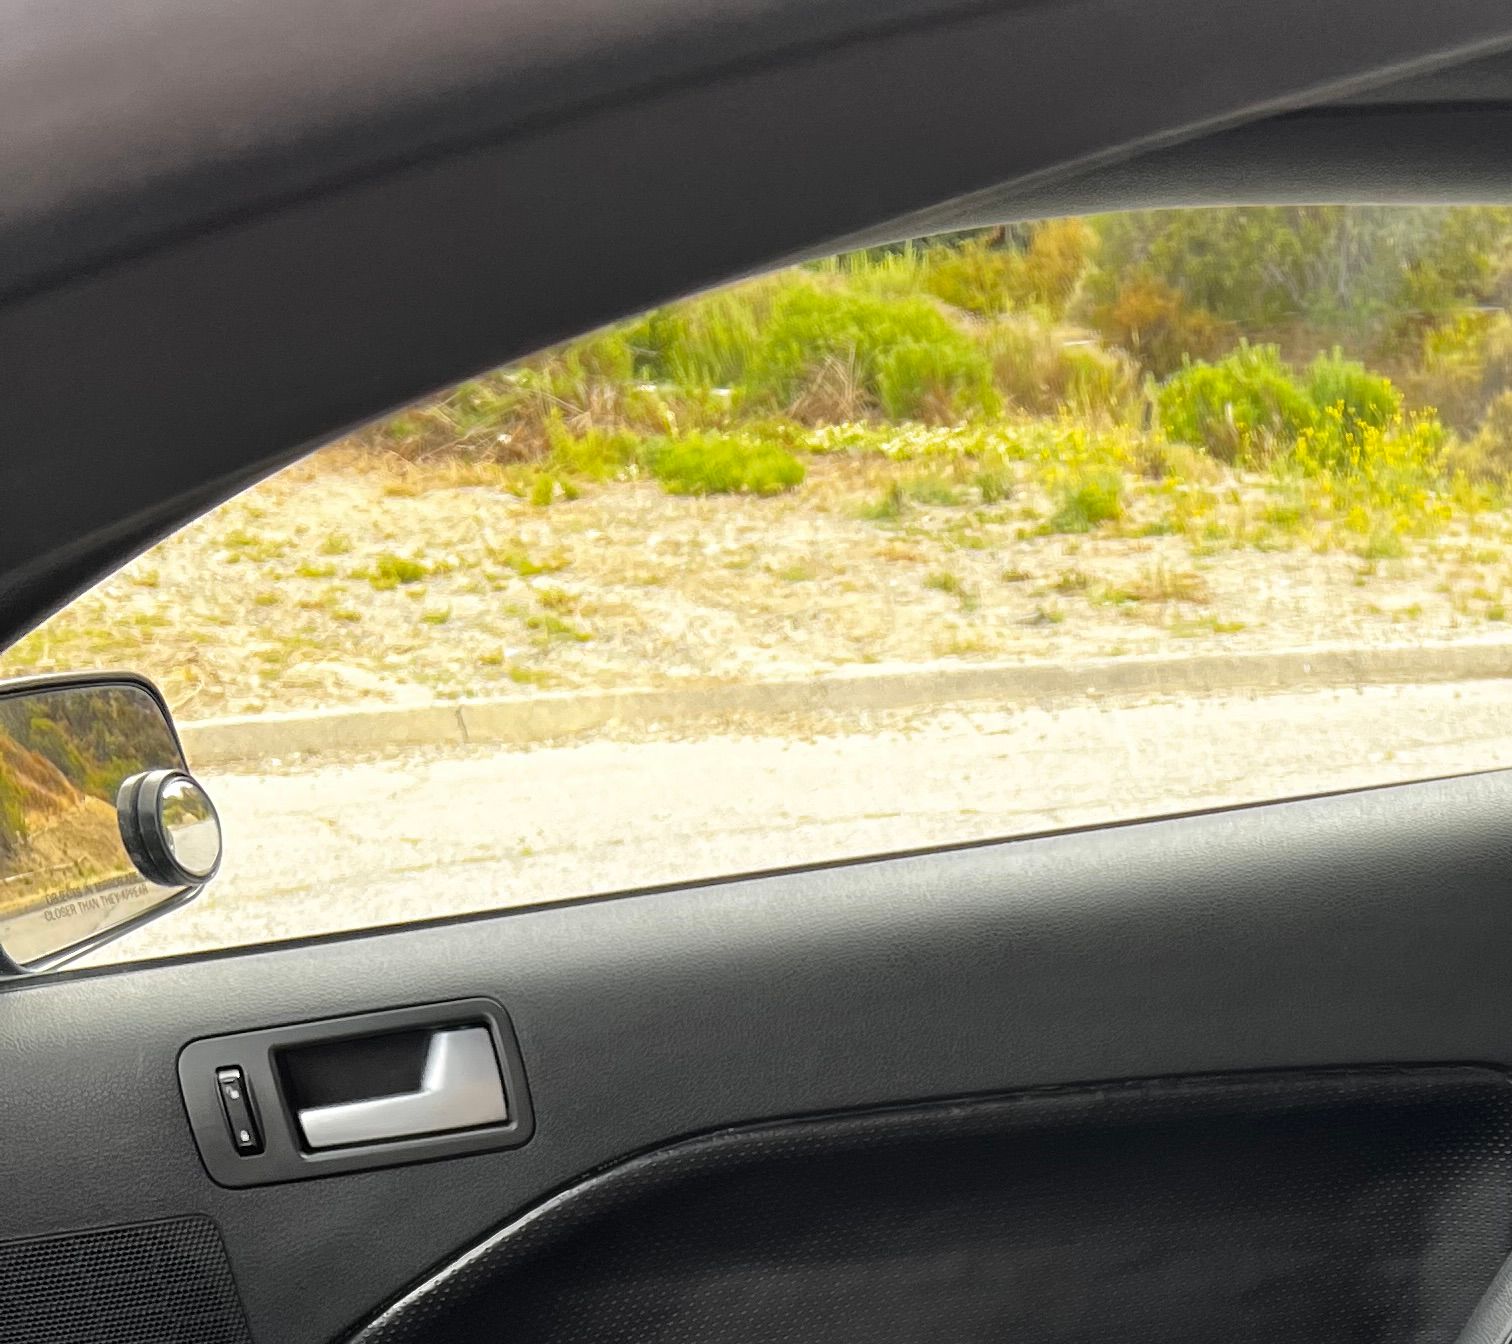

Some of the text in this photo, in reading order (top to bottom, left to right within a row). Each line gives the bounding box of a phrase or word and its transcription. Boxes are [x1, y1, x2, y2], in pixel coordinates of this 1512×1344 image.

[43, 902, 77, 921] CLOSER
[77, 897, 99, 912] THAN
[99, 891, 120, 906] THEY
